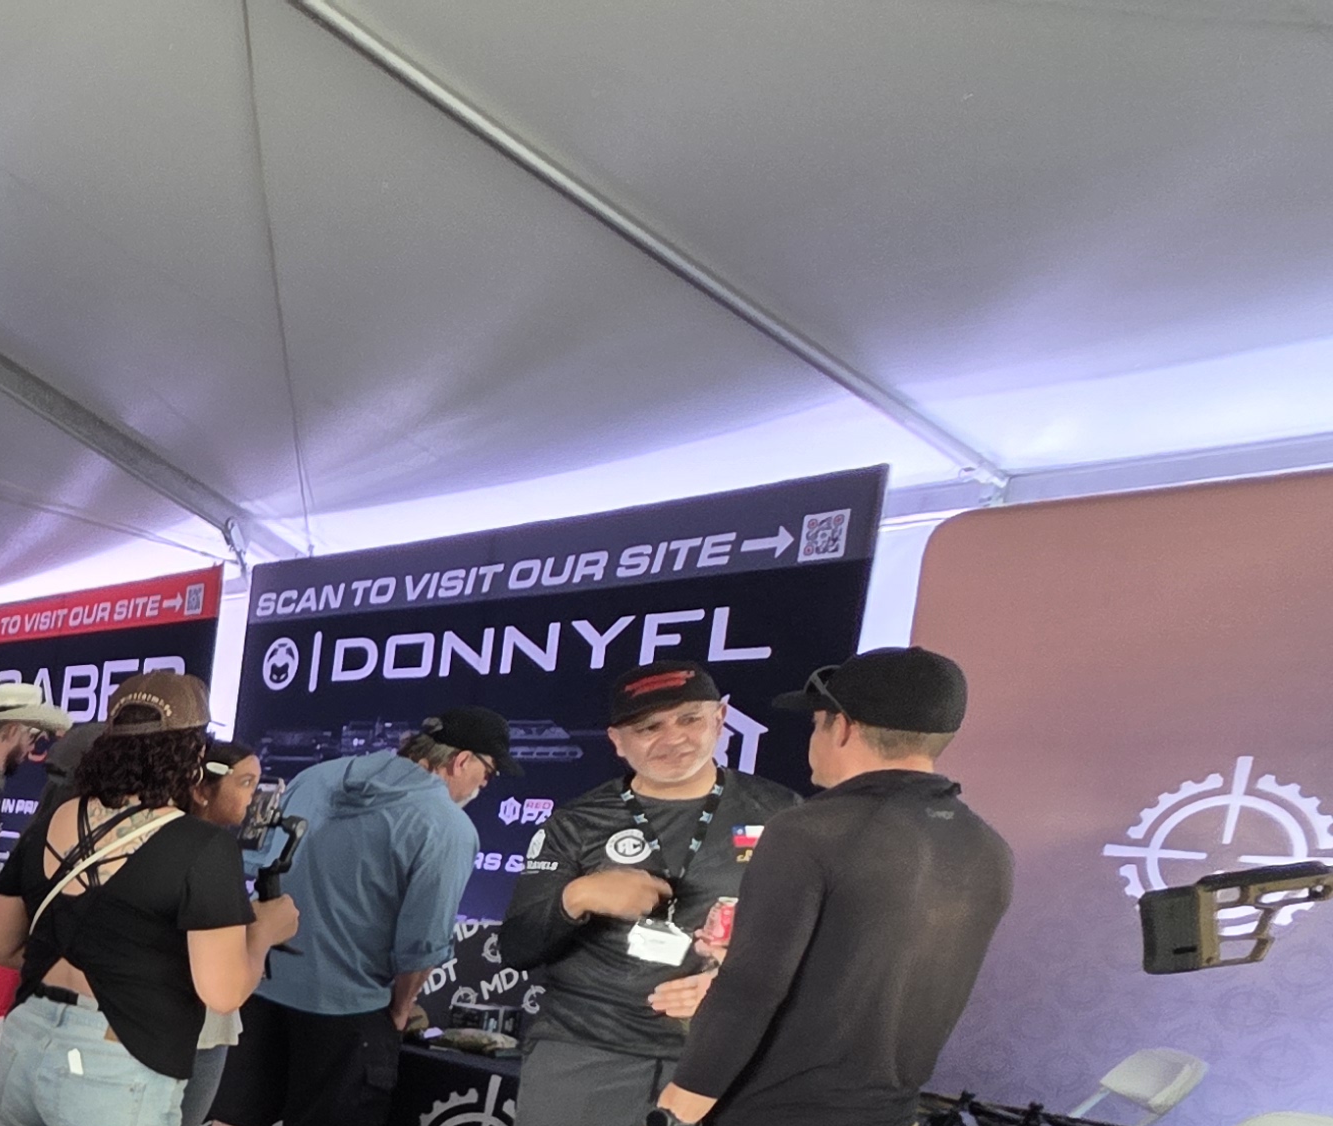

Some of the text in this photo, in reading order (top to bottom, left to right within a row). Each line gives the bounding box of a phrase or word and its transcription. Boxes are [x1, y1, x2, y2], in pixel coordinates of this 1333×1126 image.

[255, 532, 737, 617] SCAN TO VISIT OUR SITE
[1, 616, 21, 635] TO
[24, 609, 68, 632] VISIT
[69, 601, 111, 627] OUR
[113, 594, 162, 621] SITE
[331, 606, 773, 682] DONNYFL
